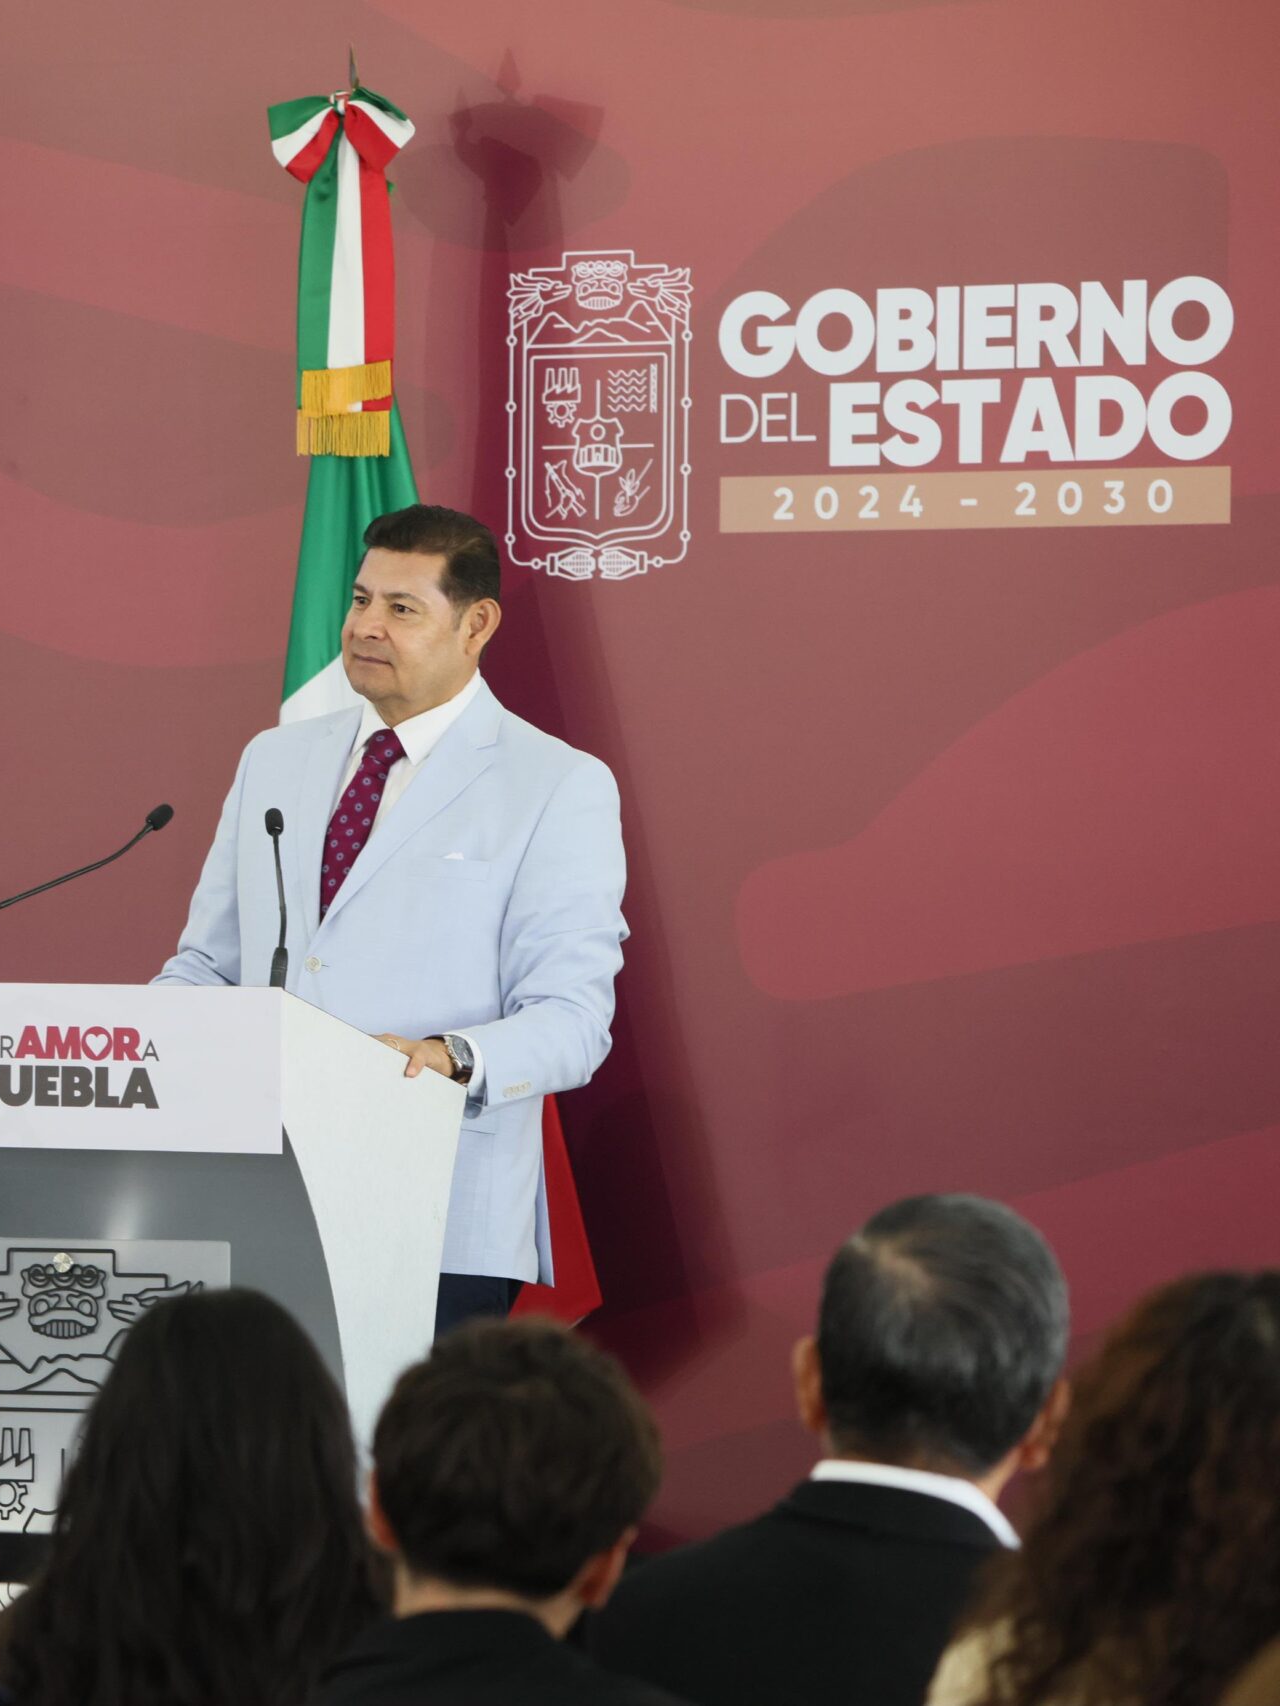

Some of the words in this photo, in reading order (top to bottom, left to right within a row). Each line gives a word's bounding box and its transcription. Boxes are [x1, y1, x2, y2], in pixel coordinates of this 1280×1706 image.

[718, 275, 1234, 378] GOBIERNO
[720, 392, 817, 443] DEL
[828, 370, 1233, 467] ESTADO
[772, 484, 924, 520] 2024
[1014, 479, 1174, 517] 2030
[15, 1025, 142, 1062] AMOR
[142, 1039, 160, 1062] A
